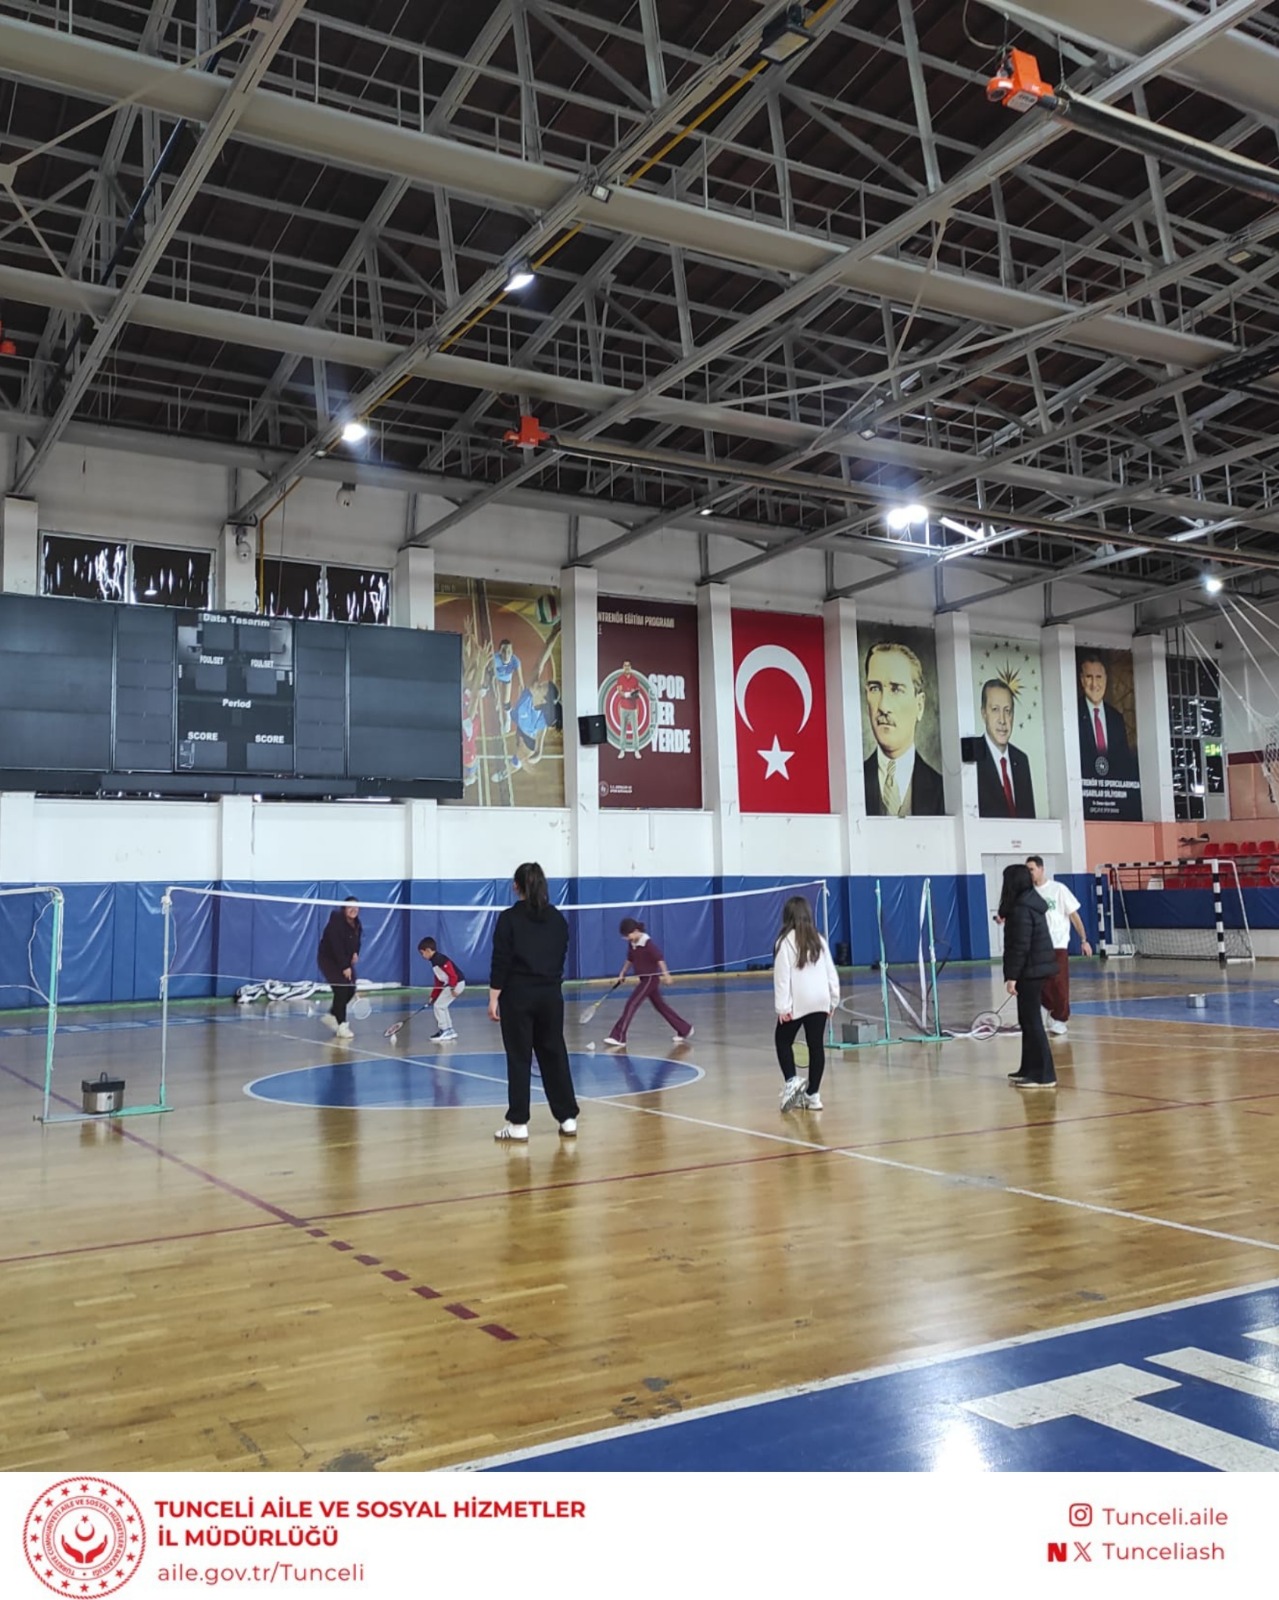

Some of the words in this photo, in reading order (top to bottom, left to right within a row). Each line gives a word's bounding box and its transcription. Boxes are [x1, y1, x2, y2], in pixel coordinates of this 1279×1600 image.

[203, 613, 227, 623] Data
[648, 673, 685, 700] SPOR
[222, 698, 251, 708] Period
[187, 731, 218, 741] SCORE
[255, 734, 284, 744] SCORE
[650, 727, 691, 754] YERDE
